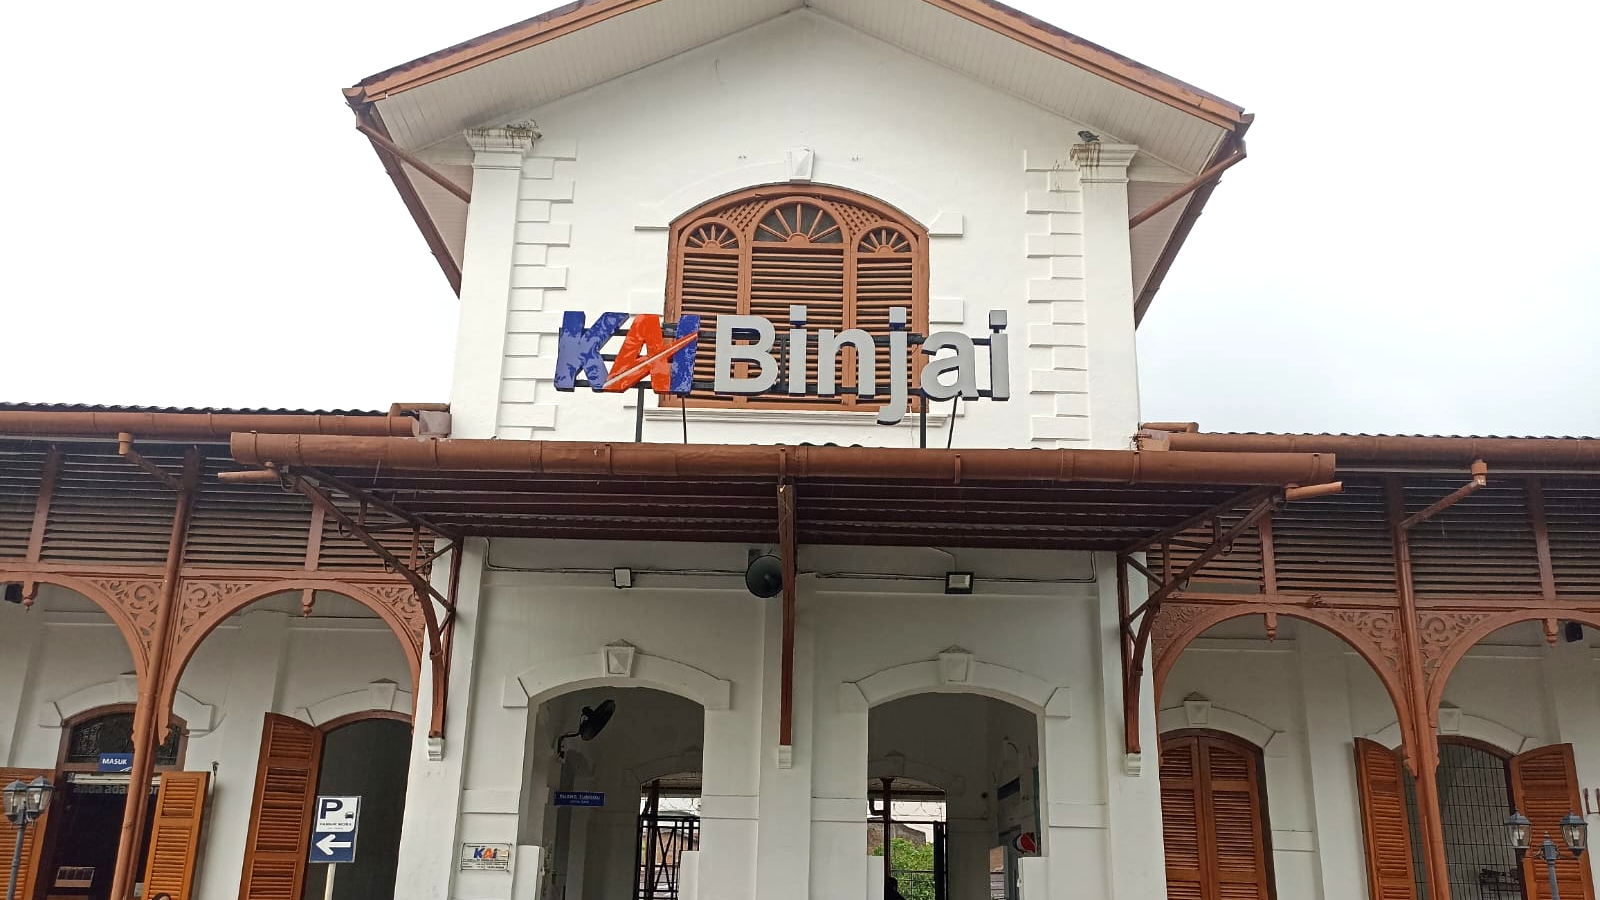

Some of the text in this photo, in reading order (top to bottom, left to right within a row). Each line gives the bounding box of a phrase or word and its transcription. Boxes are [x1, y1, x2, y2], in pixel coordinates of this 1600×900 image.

[553, 305, 1010, 425] KAI Binjai
[320, 799, 343, 819] P
[473, 847, 497, 859] KAI
